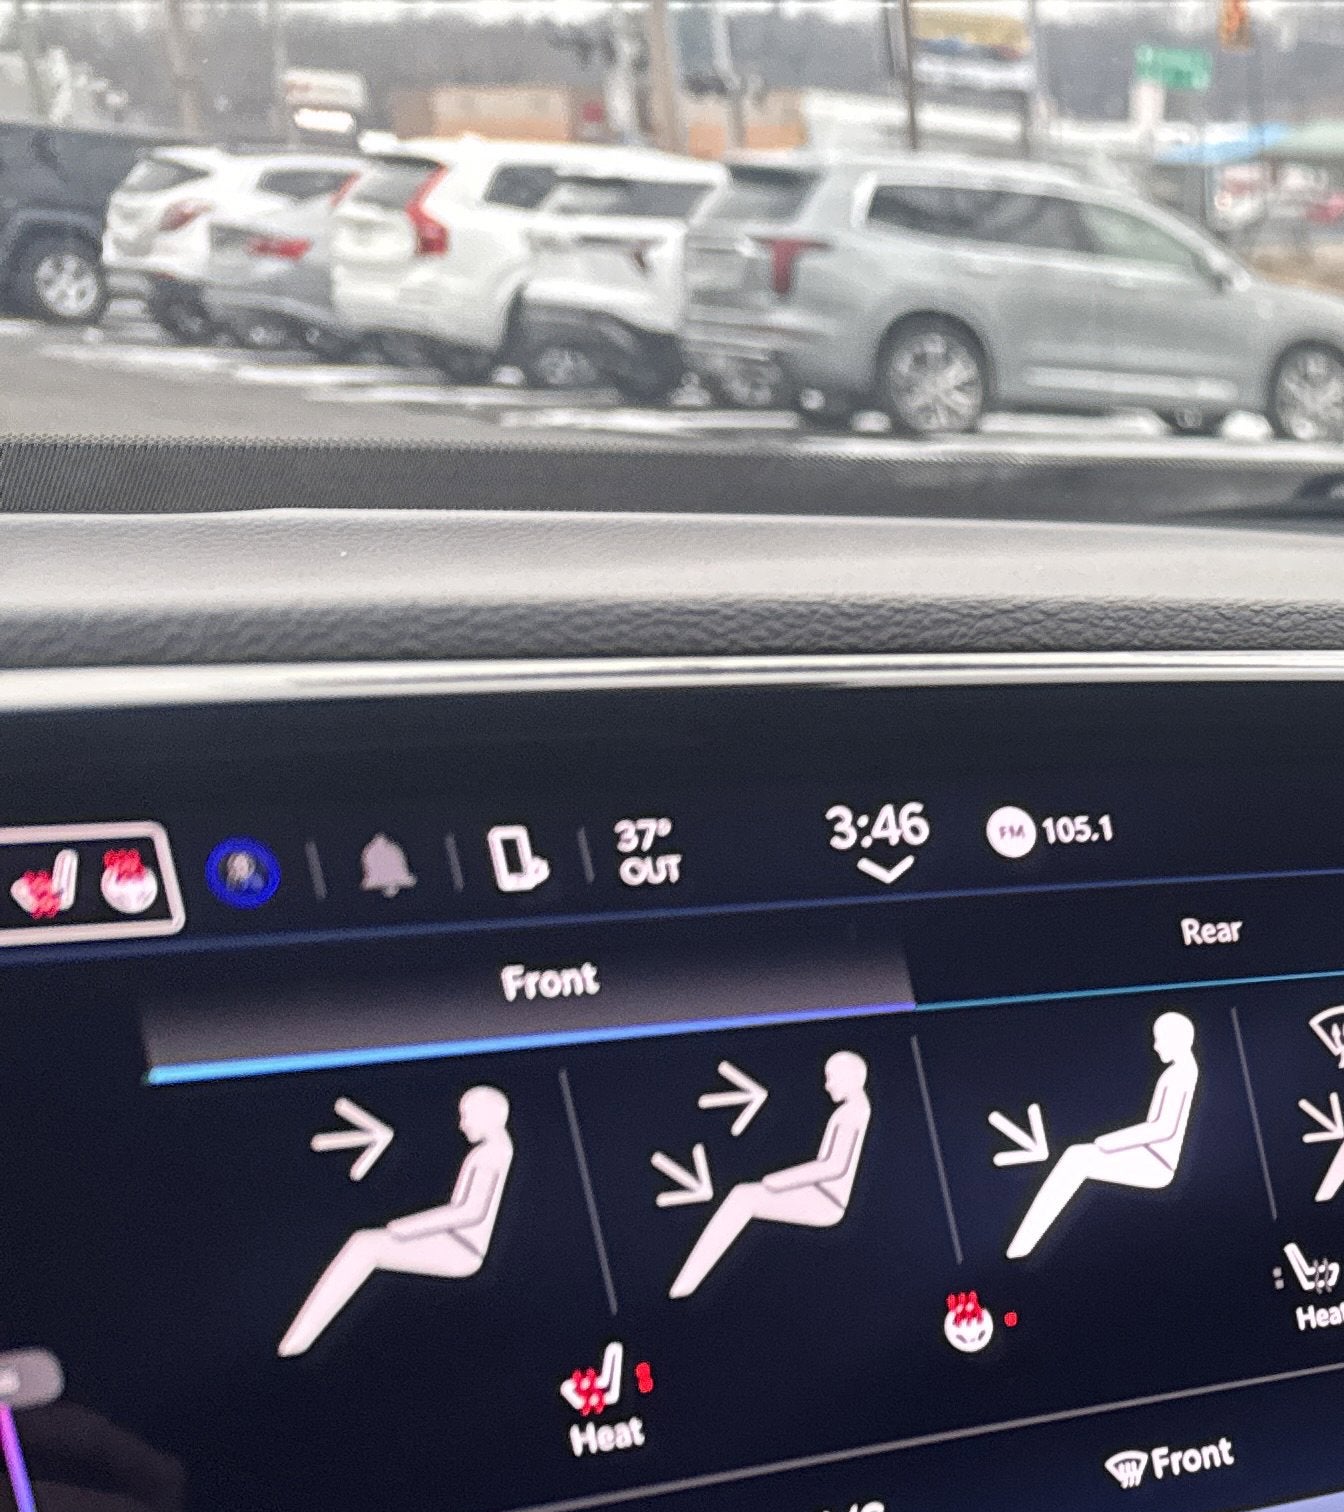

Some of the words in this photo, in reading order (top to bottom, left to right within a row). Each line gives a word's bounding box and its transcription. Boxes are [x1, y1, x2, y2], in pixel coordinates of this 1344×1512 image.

[825, 801, 932, 850] 3:46
[1042, 814, 1114, 844] 105.1
[619, 855, 682, 887] OUT
[1181, 917, 1242, 946] Rear
[501, 962, 600, 1000] Front
[569, 1417, 645, 1457] Heat
[1152, 1437, 1235, 1479] Front
